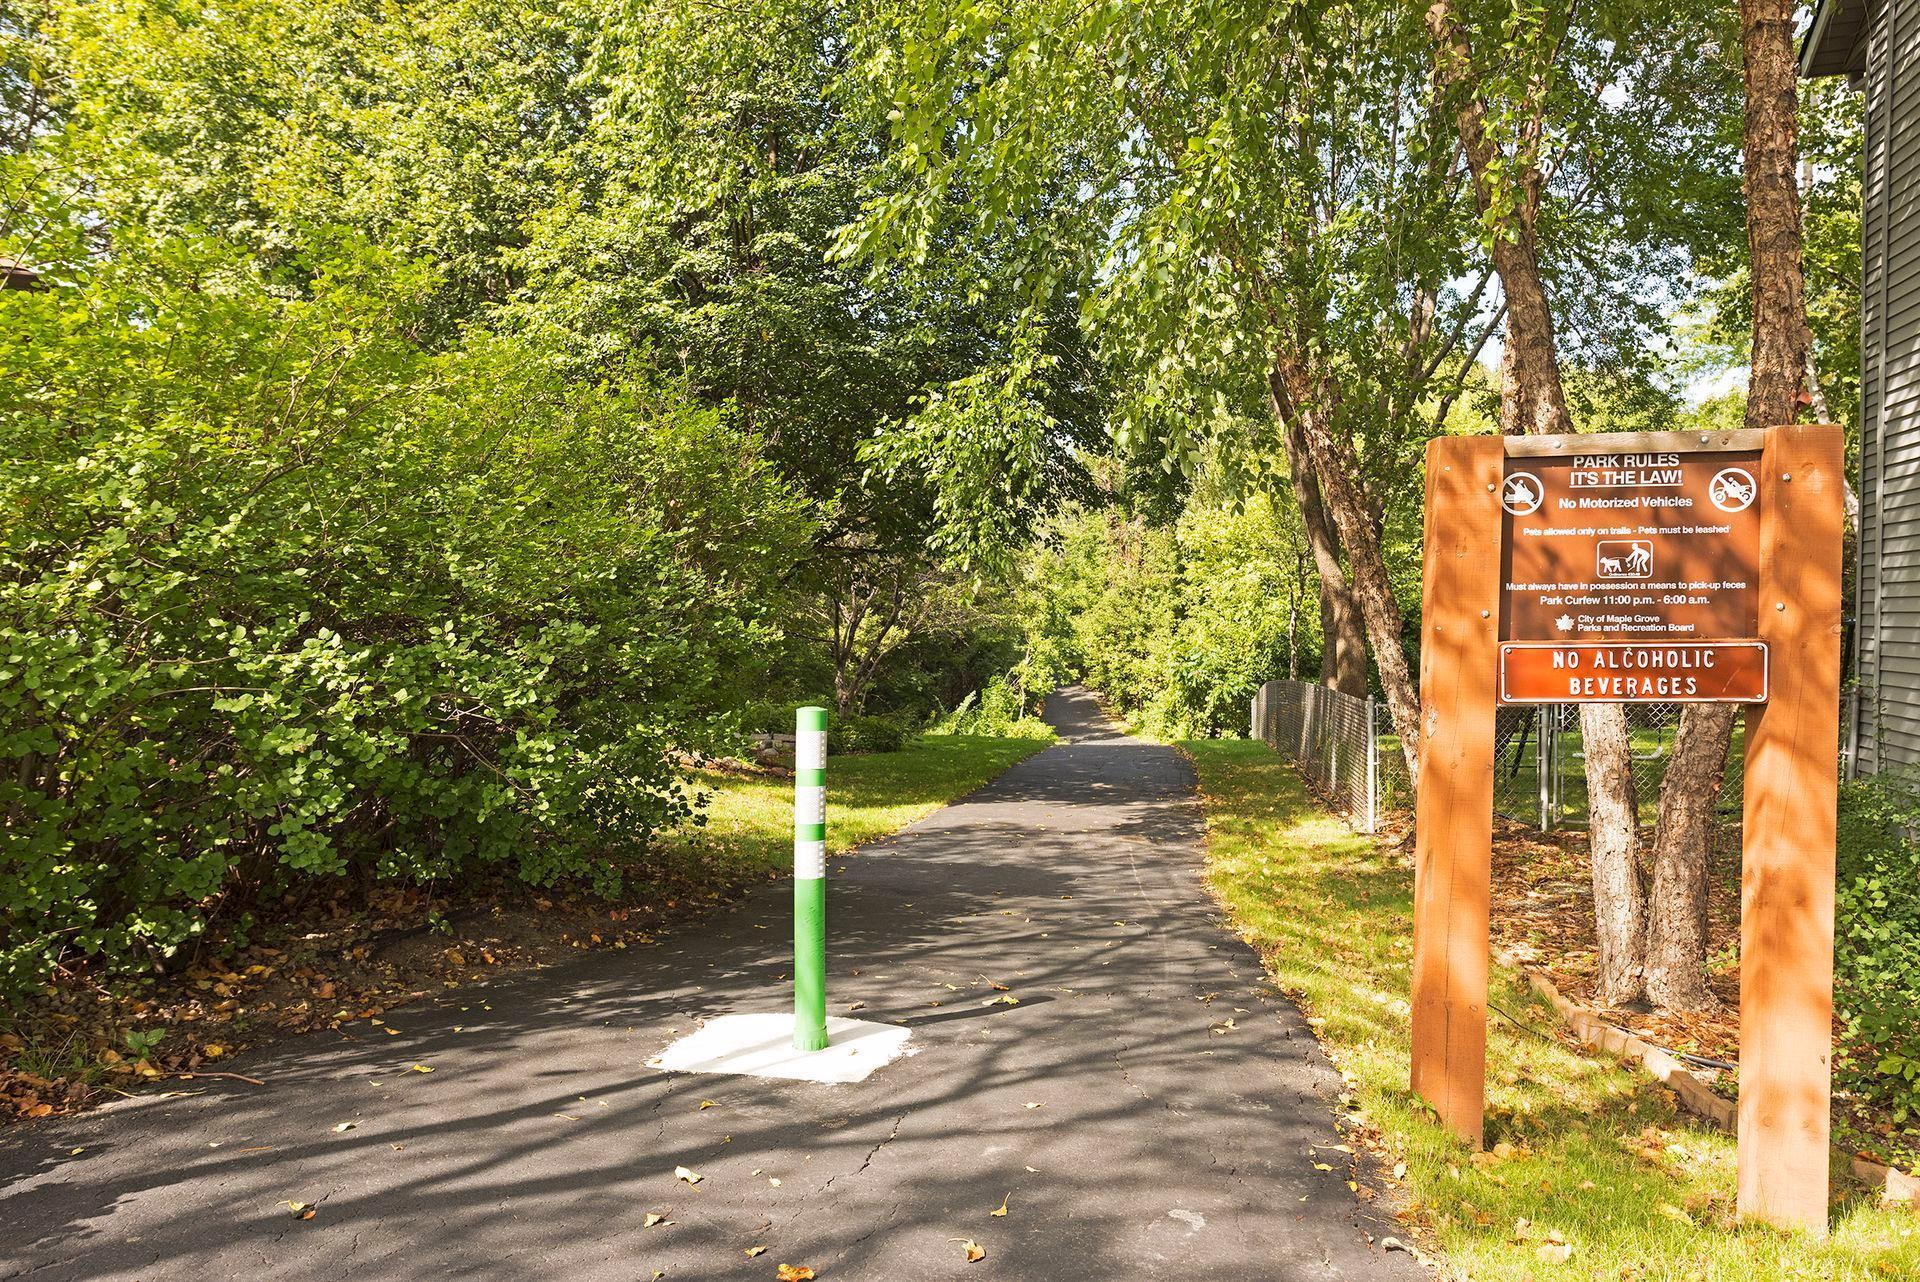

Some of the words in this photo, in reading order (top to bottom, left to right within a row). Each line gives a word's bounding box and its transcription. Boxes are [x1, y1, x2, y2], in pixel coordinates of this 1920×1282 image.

[1573, 455, 1620, 468] PARK
[1624, 454, 1680, 468] RULES
[1570, 471, 1599, 486] IT'S
[1602, 471, 1636, 484] THE
[1640, 470, 1683, 484] LAW!
[1558, 498, 1576, 508] No
[1580, 497, 1639, 508] Motorized
[1642, 496, 1692, 508] Vehicles
[1523, 528, 1542, 536] Pets
[1544, 527, 1576, 536] allowed
[1578, 527, 1596, 536] only
[1610, 526, 1632, 534] trails
[1638, 526, 1658, 534] Pets
[1682, 526, 1694, 534] be
[1696, 525, 1730, 534] leashed
[1528, 582, 1556, 592] always
[1558, 582, 1578, 590] have
[1580, 582, 1588, 590] in
[1590, 582, 1638, 592] possession
[1678, 582, 1688, 590] to
[1688, 581, 1720, 590] pick-up
[1722, 581, 1746, 589] feces
[1540, 596, 1562, 604] Park
[1564, 596, 1600, 604] Curfew
[1602, 596, 1631, 604] 11:00
[1633, 596, 1655, 606] p.m.
[1663, 594, 1686, 604] 6:00
[1688, 596, 1710, 604] a.m.
[1578, 614, 1594, 624] City
[1596, 614, 1606, 623] of
[1606, 614, 1632, 624] Maple
[1634, 614, 1660, 622] Grove
[1578, 624, 1601, 632] Parks
[1621, 624, 1666, 632] Recreation
[1668, 624, 1694, 632] Board
[1552, 650, 1580, 669] NO
[1594, 650, 1715, 669] ALCOHOLIC
[1569, 677, 1698, 695] BEVERAGES
